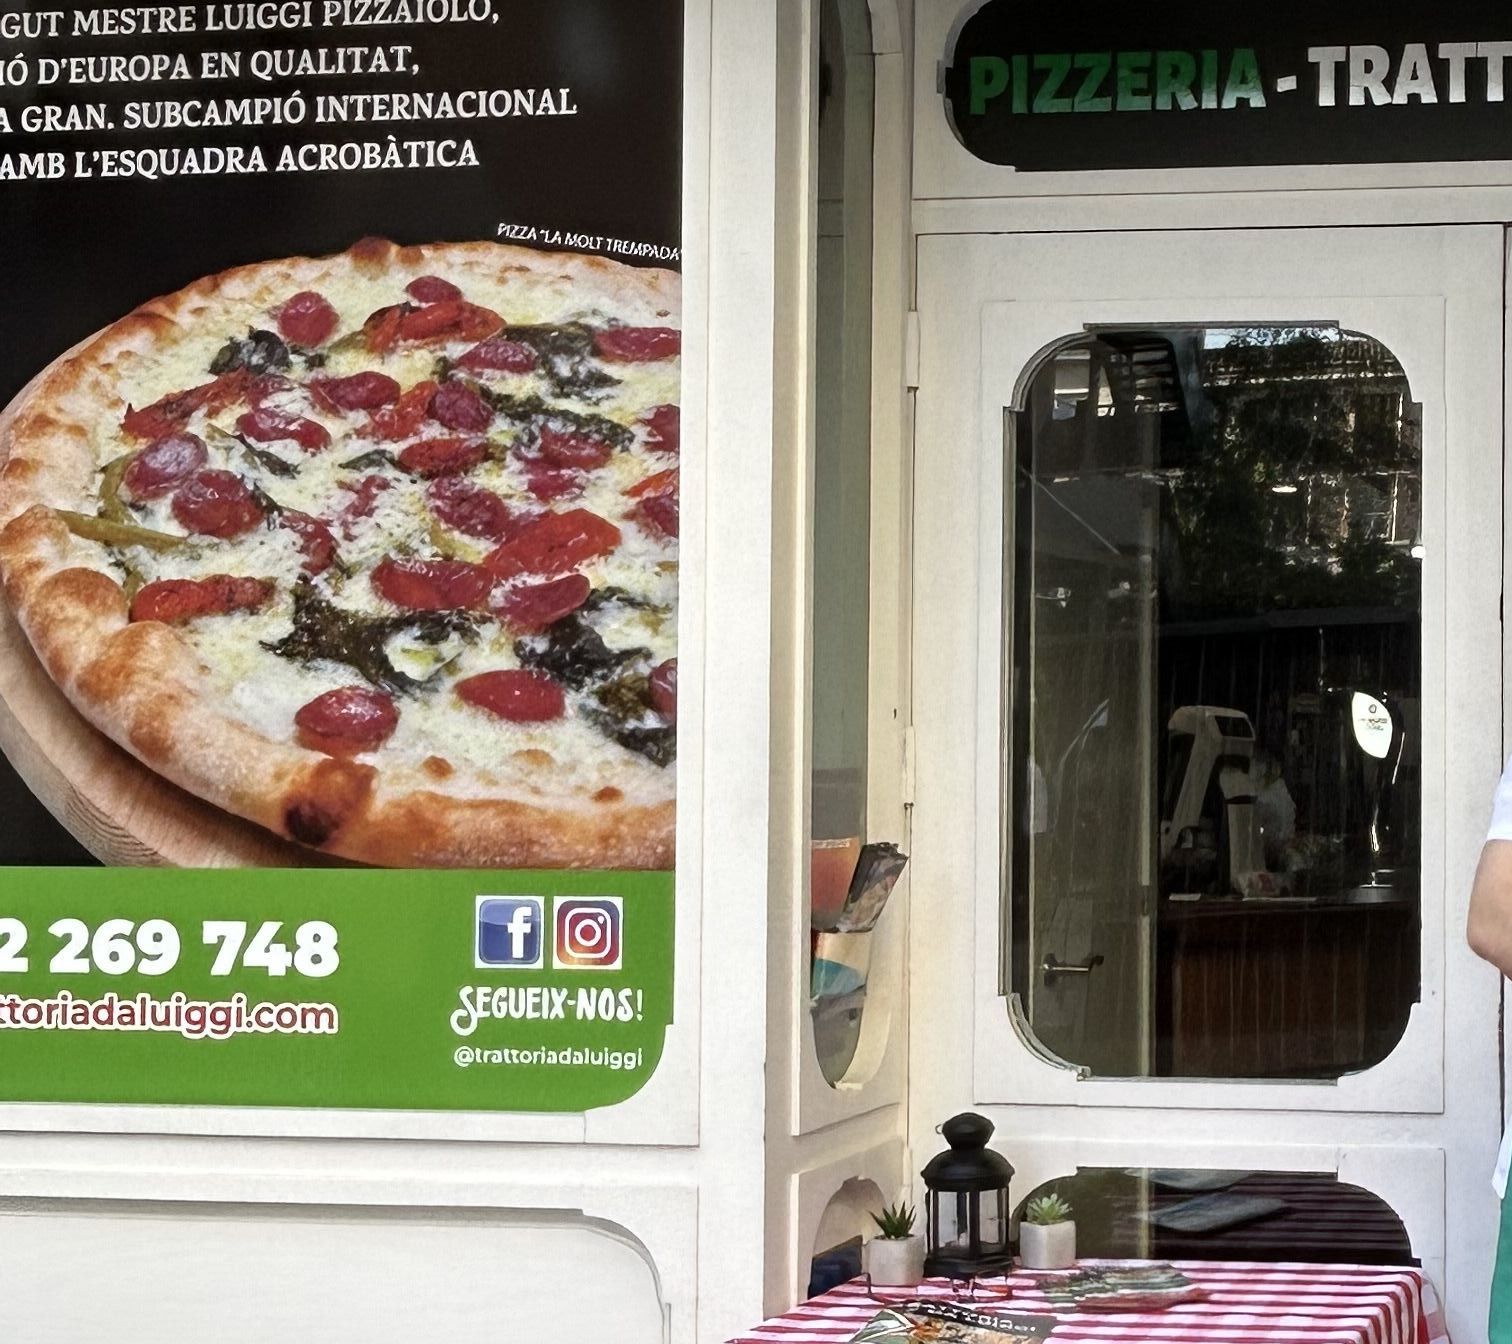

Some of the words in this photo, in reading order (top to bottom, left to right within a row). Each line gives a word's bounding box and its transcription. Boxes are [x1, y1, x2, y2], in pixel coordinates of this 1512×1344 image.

[0, 10, 65, 40] GUT
[71, 5, 198, 37] MESTRE
[204, 0, 313, 31] LUIGGI
[36, 52, 194, 86] D'EUROPA
[200, 49, 242, 79] EN
[249, 44, 421, 82] QUALITAT,
[969, 47, 1268, 116] PIZZERIA
[20, 102, 116, 134] GRAN.
[122, 90, 306, 130] SUBCAMPIÓ
[314, 88, 578, 124] INTERNACIONAL
[0, 152, 66, 181] AMB
[74, 142, 268, 181] L'ESQUADRA
[276, 135, 480, 173] ACROBÀTICA
[496, 222, 538, 242] PIZZA
[564, 233, 604, 250] MOLT
[0, 917, 29, 974] 2
[47, 917, 182, 976] 269
[201, 919, 341, 978] 748
[450, 984, 644, 1037] SEGUEIX-NOS!
[453, 1045, 644, 1071] @trattoriadaluiggi
